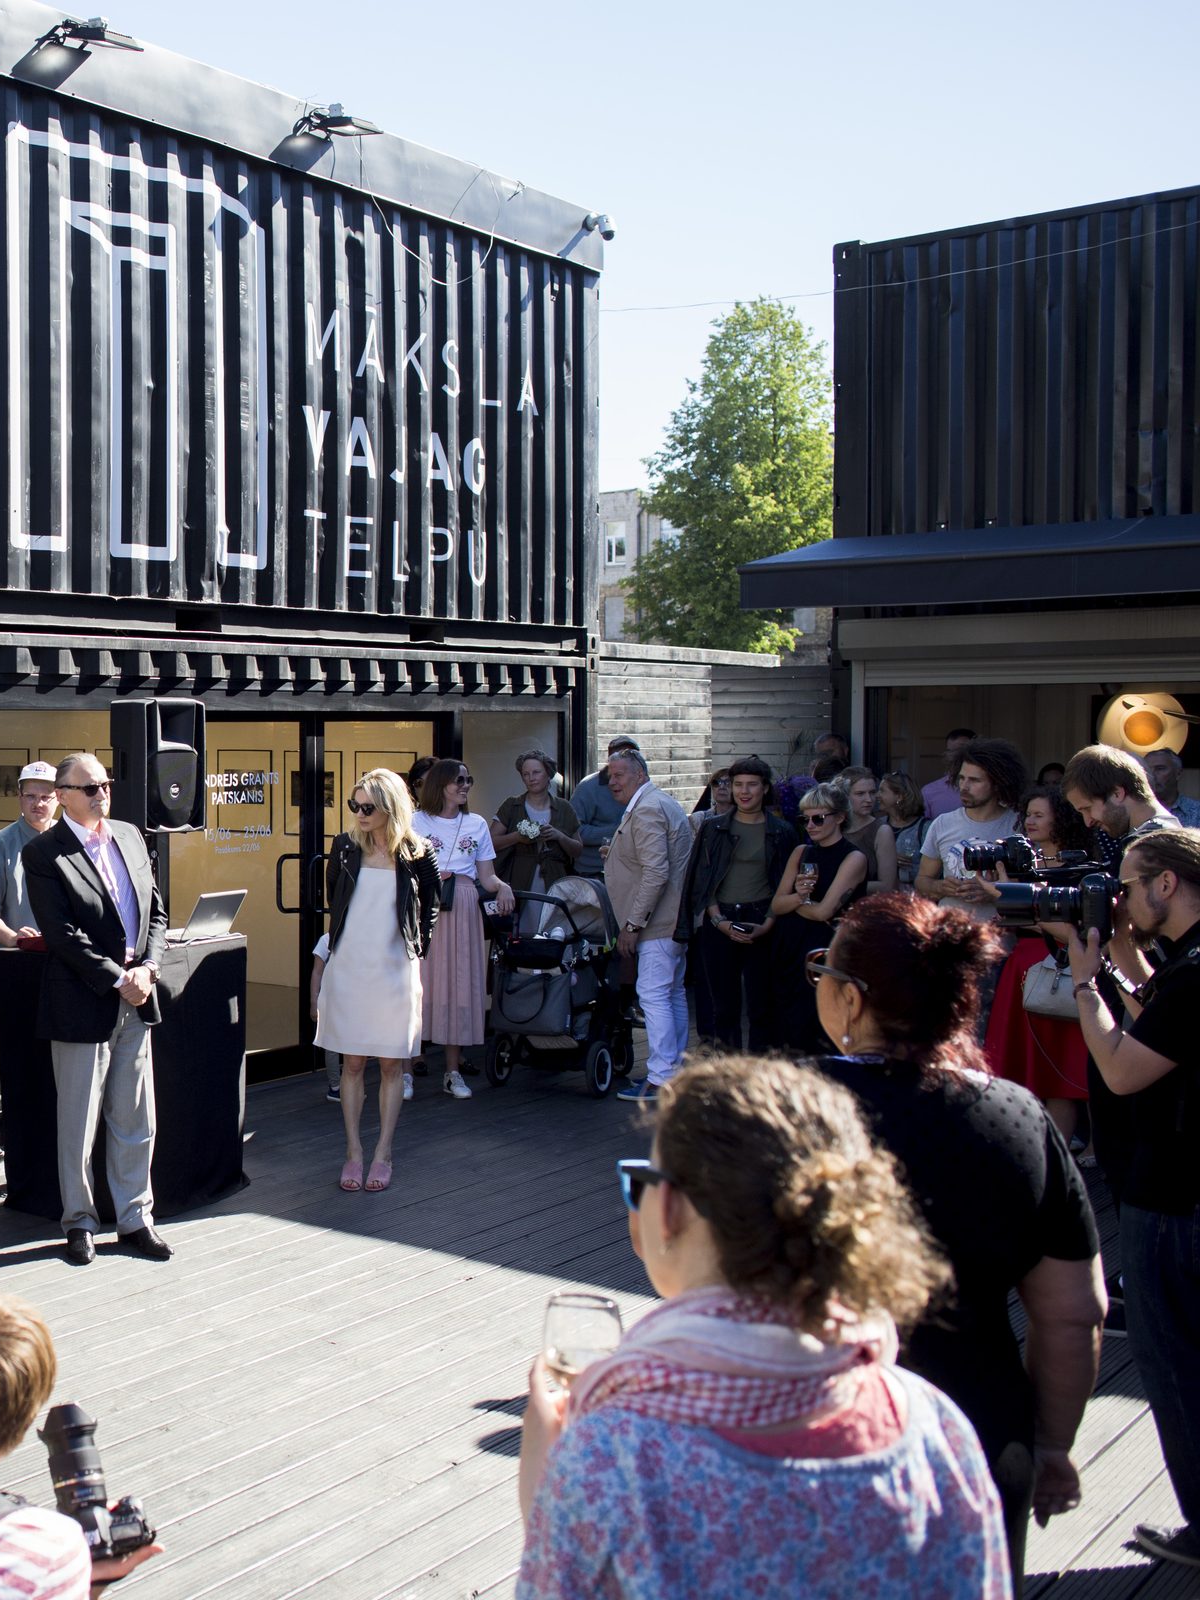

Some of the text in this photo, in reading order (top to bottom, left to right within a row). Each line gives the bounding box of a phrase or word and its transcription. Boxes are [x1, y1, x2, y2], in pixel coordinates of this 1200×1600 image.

[306, 302, 539, 416] MĀKSLA
[302, 405, 486, 496] VAJAG
[303, 509, 487, 587] TELPU
[204, 772, 279, 788] NDREJS GRANTS
[211, 790, 263, 805] PATSKANIS
[244, 824, 271, 839] 25/06
